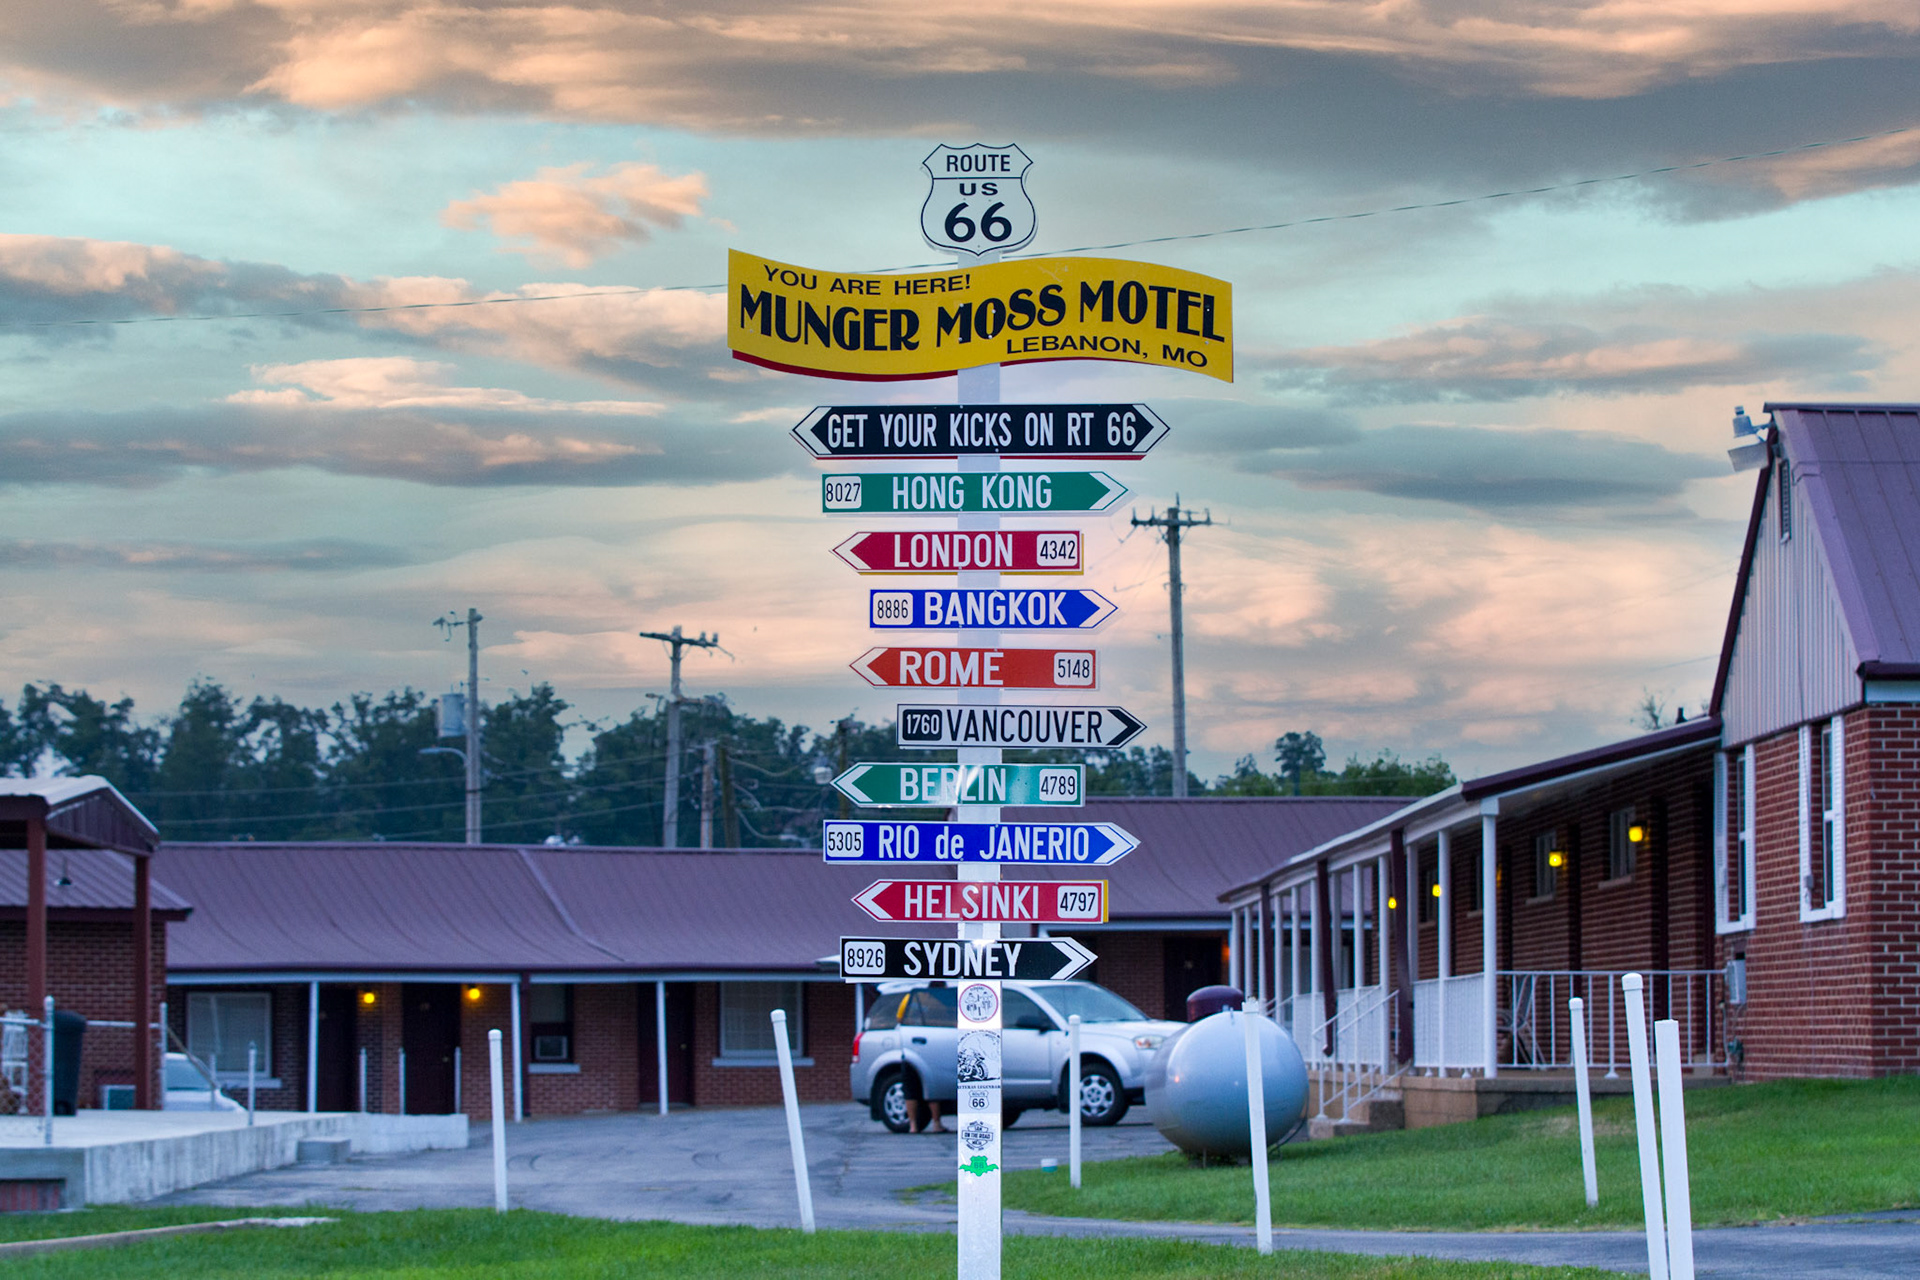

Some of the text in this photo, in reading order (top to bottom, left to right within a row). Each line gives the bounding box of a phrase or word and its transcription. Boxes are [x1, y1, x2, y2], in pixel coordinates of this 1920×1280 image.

[946, 154, 1011, 173] ROUTE
[959, 182, 999, 196] US
[944, 202, 1013, 242] 66
[763, 265, 972, 296] YOU ARE HERE!
[740, 280, 1226, 351] MUNGER MOSS MOTEL
[1006, 336, 1208, 368] LEBANON, MO
[827, 412, 1137, 448] GET YOUR KICKS ON RT 66
[825, 475, 1052, 510] 8027 HONG KONG
[894, 534, 1076, 567] LONDON 4342
[877, 592, 1067, 625] 8886 BANGKOK
[900, 651, 1091, 685] ROME 5148
[906, 709, 1102, 743] 1760 VANCOUVER
[901, 768, 1076, 801] BERLIN 4789
[827, 825, 1090, 861] 5305 RIO de JANERIO
[904, 885, 1096, 918] HELSINKI 4797
[847, 942, 1022, 977] 8926 SYDNEY
[972, 1098, 985, 1107] 66
